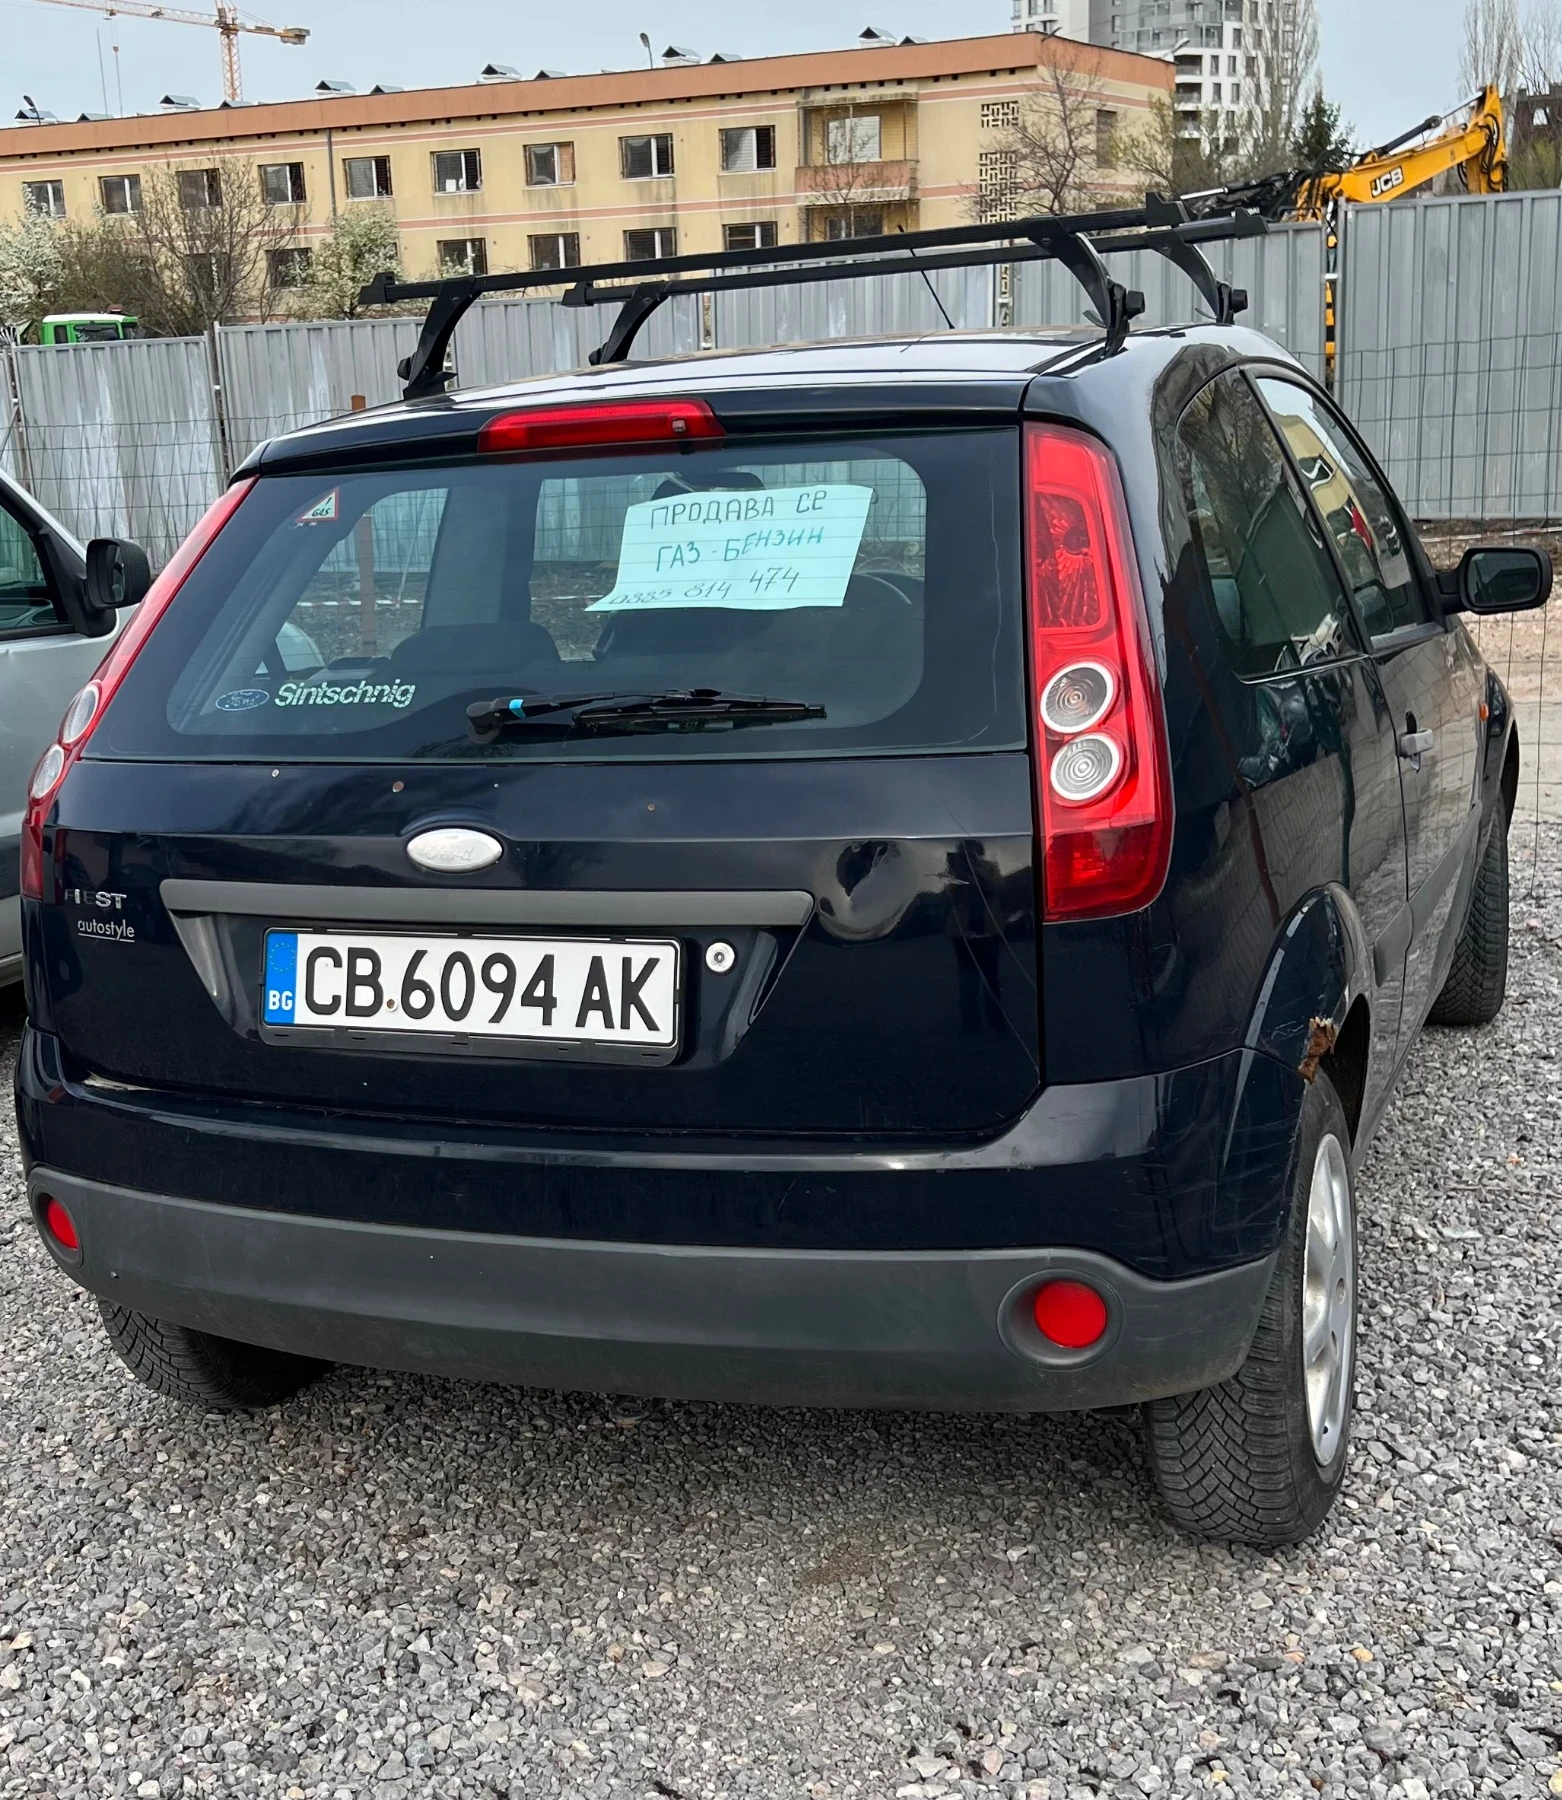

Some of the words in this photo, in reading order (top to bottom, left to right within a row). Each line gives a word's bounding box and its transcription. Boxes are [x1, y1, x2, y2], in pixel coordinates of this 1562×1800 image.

[1371, 167, 1404, 197] JCB
[651, 496, 775, 530] ПРОДАВА
[656, 541, 701, 572] ГАЗ
[723, 526, 825, 562] БЕНЗИН
[684, 581, 733, 600] 814
[749, 566, 800, 594] 474
[274, 678, 417, 709] Sintschnig
[77, 919, 135, 941] autostyle
[268, 991, 293, 1012] BG
[305, 946, 384, 1018] CB
[401, 949, 558, 1026] 6094
[575, 955, 661, 1032] AK
